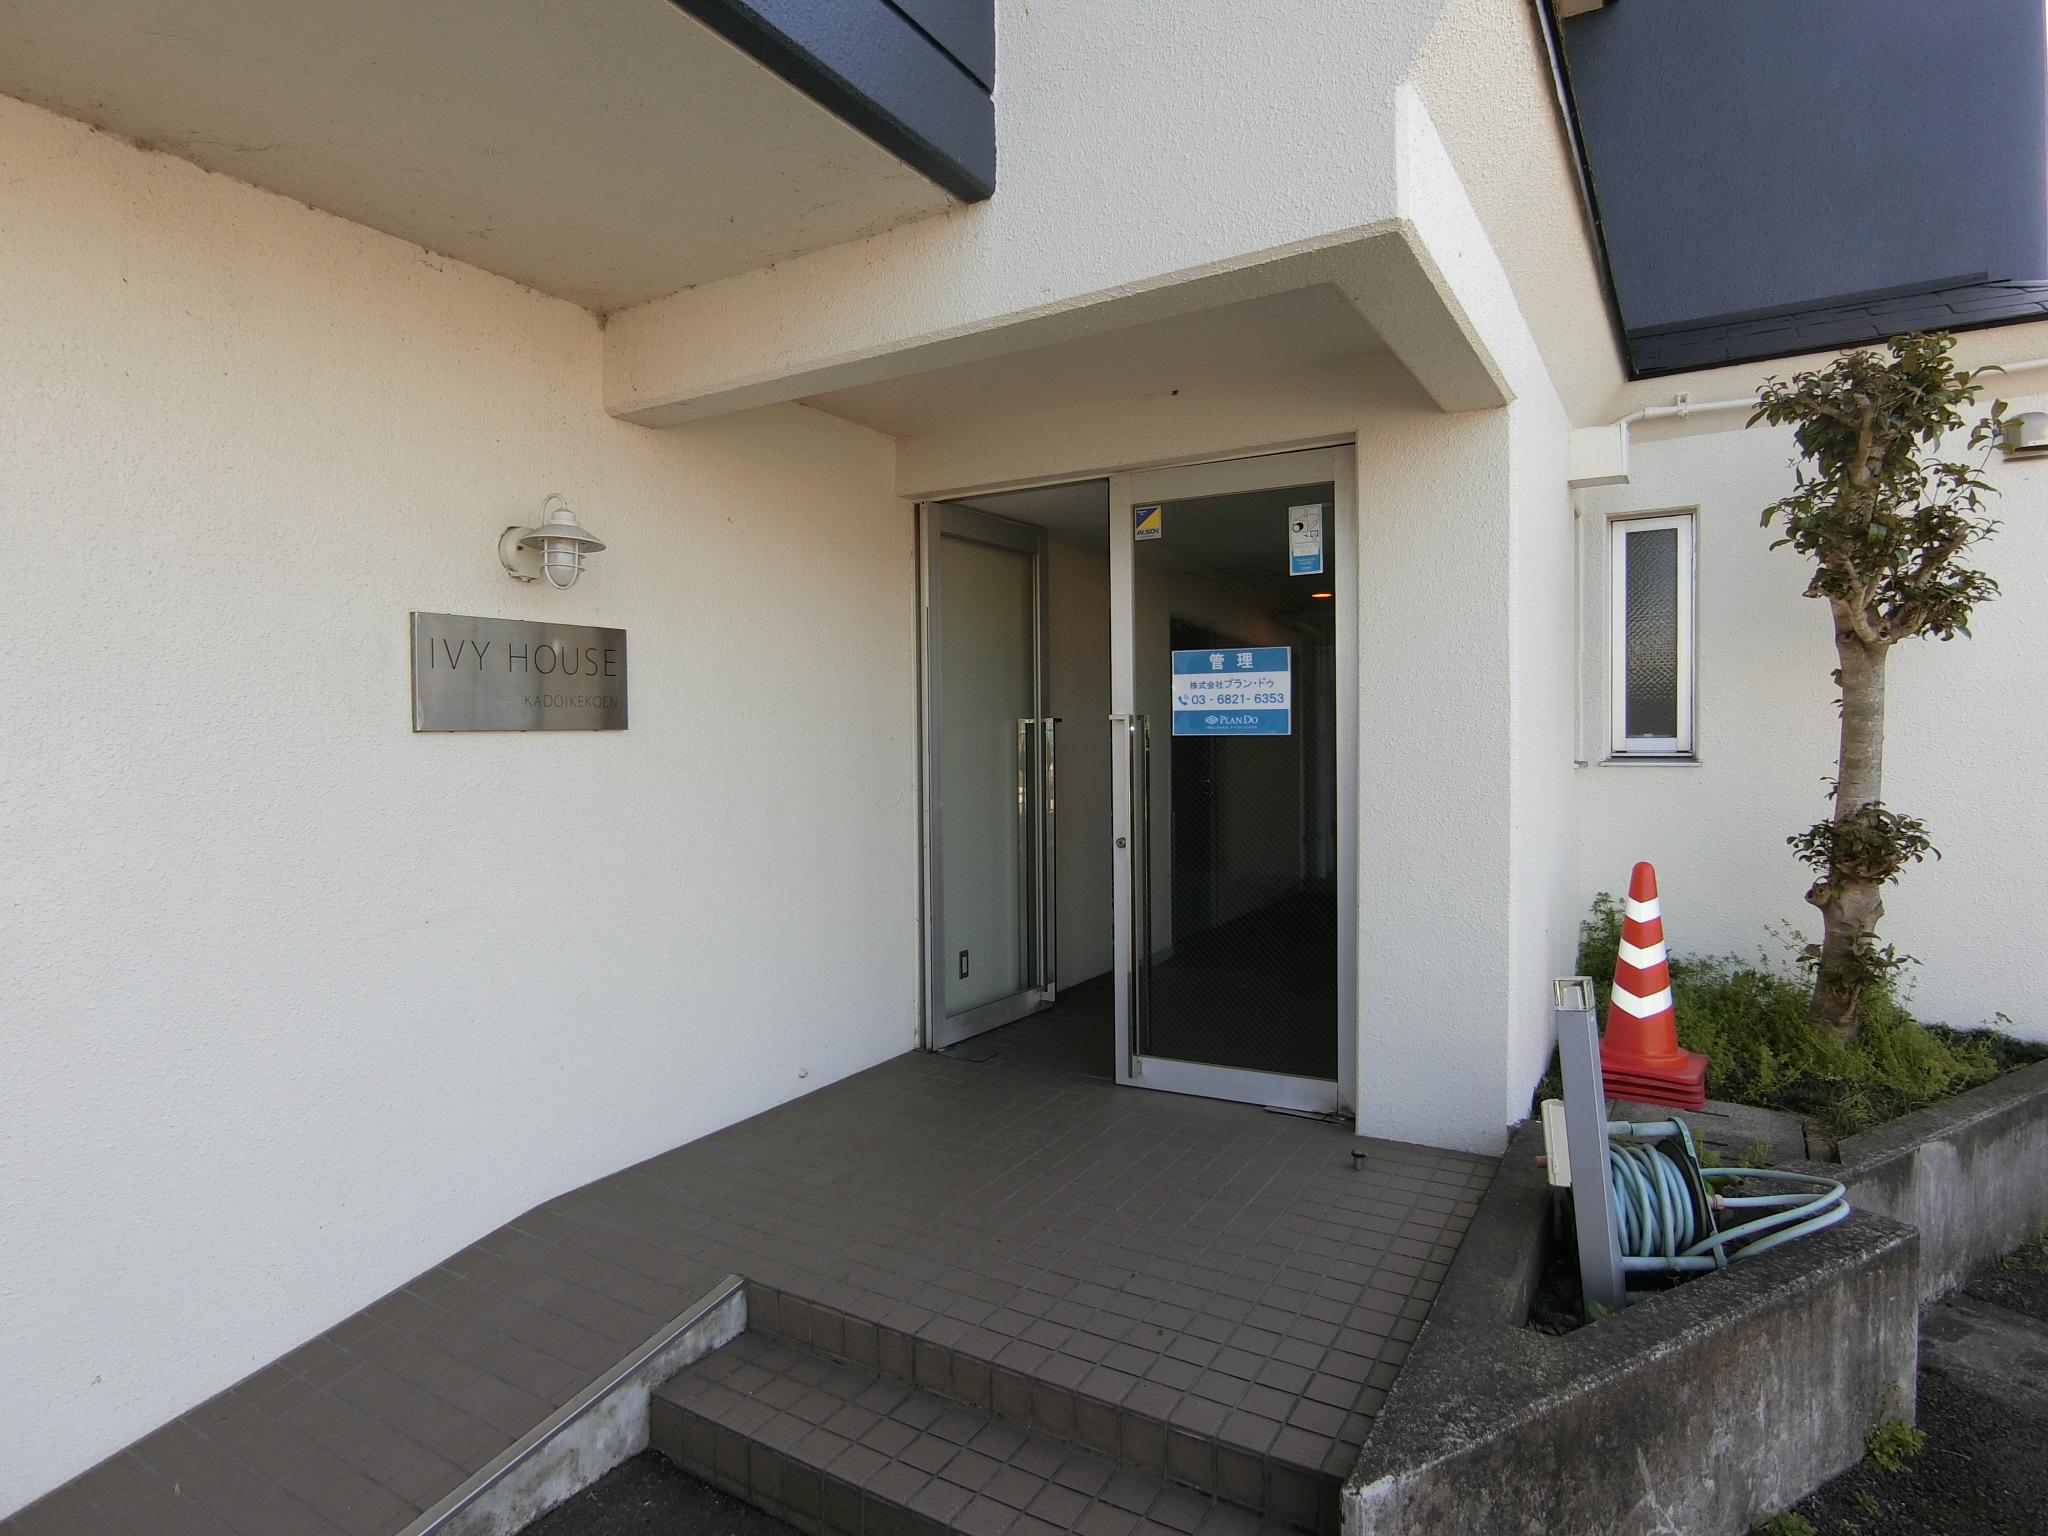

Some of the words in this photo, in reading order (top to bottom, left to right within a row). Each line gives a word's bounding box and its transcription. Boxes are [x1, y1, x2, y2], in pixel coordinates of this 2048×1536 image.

[431, 637, 491, 671] IVY
[509, 643, 617, 677] HOUSE
[525, 694, 618, 708] KADOIKEKOEN
